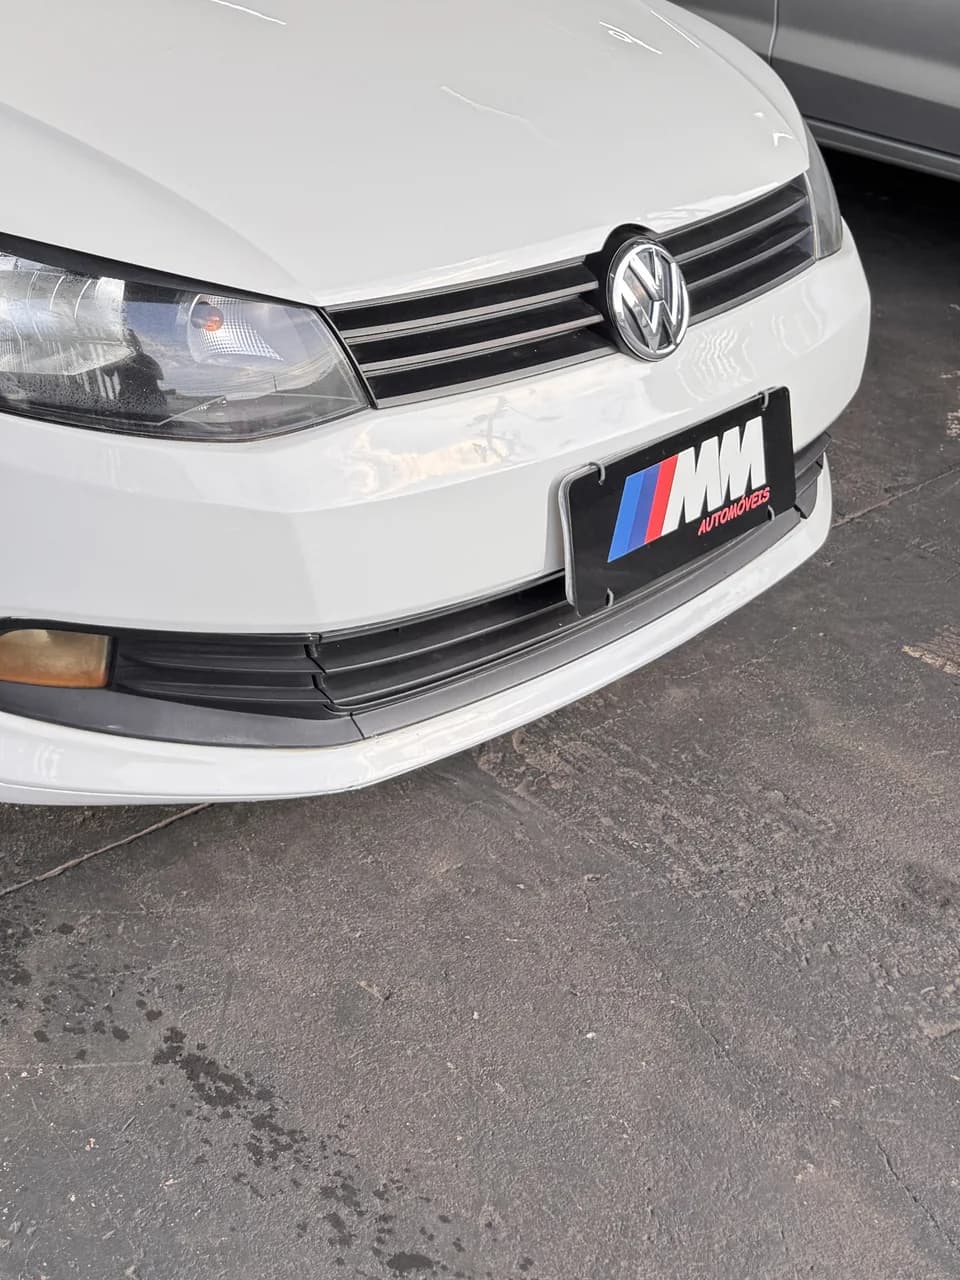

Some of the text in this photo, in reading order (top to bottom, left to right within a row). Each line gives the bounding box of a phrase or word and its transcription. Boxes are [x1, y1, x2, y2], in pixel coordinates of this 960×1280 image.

[610, 242, 686, 357] VW
[661, 416, 767, 536] MM
[697, 486, 771, 536] AUTOMÓVEIS
